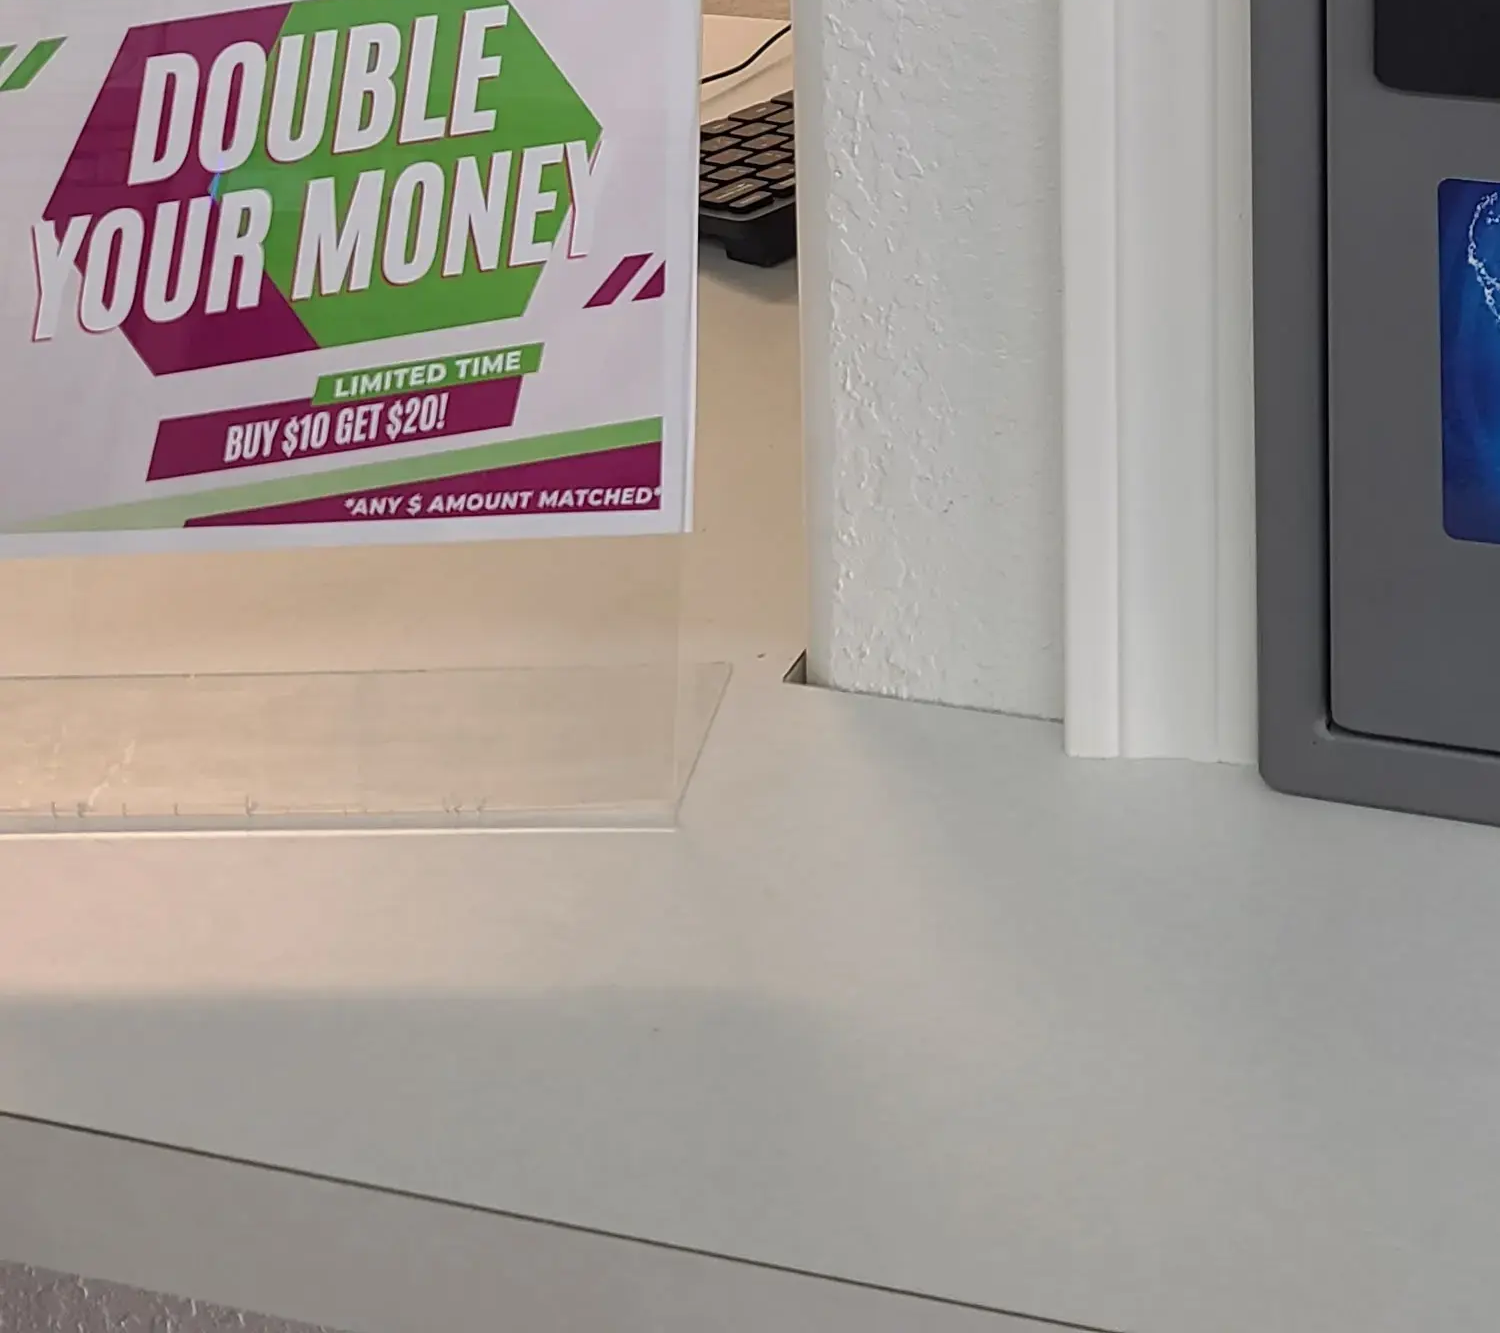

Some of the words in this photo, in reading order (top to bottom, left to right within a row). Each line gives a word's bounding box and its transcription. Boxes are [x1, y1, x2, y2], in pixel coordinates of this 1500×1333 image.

[126, 4, 509, 187] DOUBLE
[30, 188, 273, 343] YOUR
[290, 139, 605, 303] MONEY
[333, 362, 447, 399] LIMITED
[456, 350, 522, 378] TIME
[224, 424, 278, 464] BUY
[282, 411, 330, 459] $10
[335, 408, 382, 446] GET
[385, 393, 448, 441] $20!
[406, 493, 422, 515] $
[427, 489, 535, 513] AMOUNT
